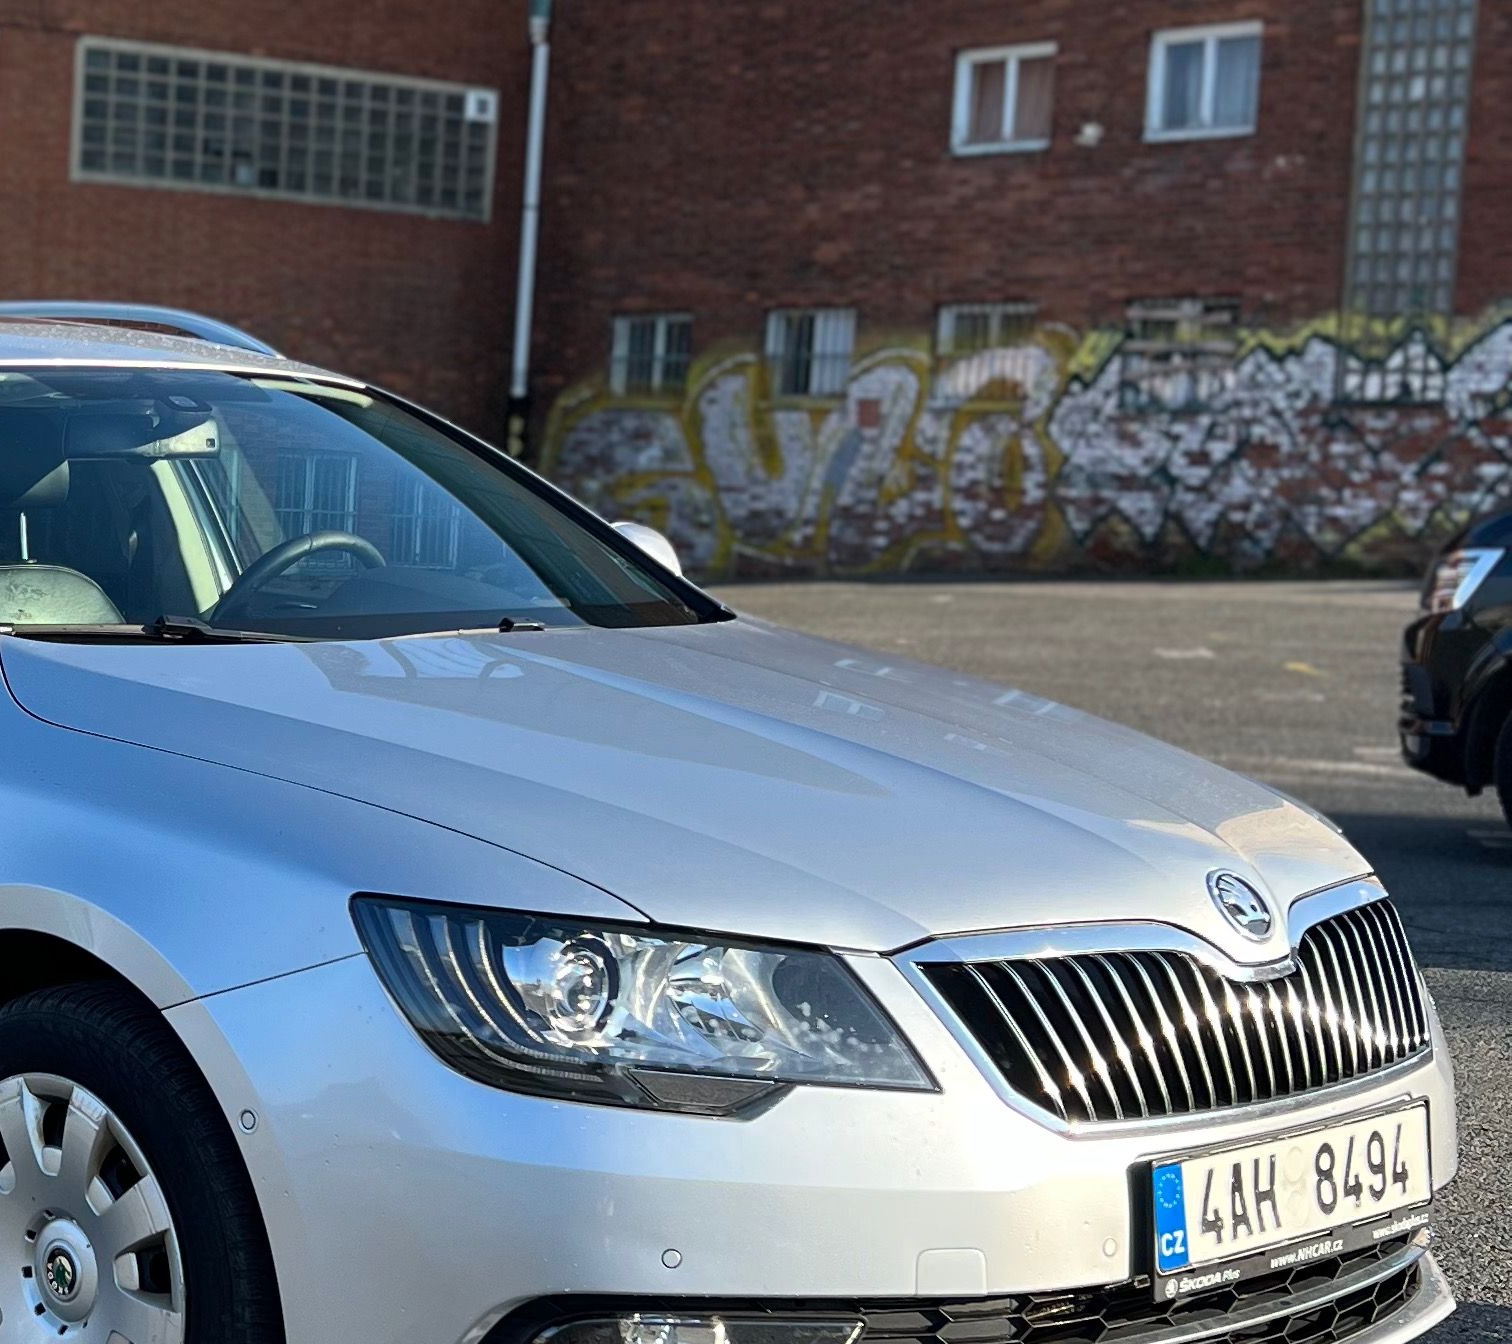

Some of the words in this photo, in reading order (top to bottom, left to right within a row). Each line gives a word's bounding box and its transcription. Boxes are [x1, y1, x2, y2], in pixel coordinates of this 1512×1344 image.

[1200, 1154, 1282, 1244] 4AH
[1314, 1123, 1409, 1216] 8494
[1161, 1229, 1185, 1257] CZ
